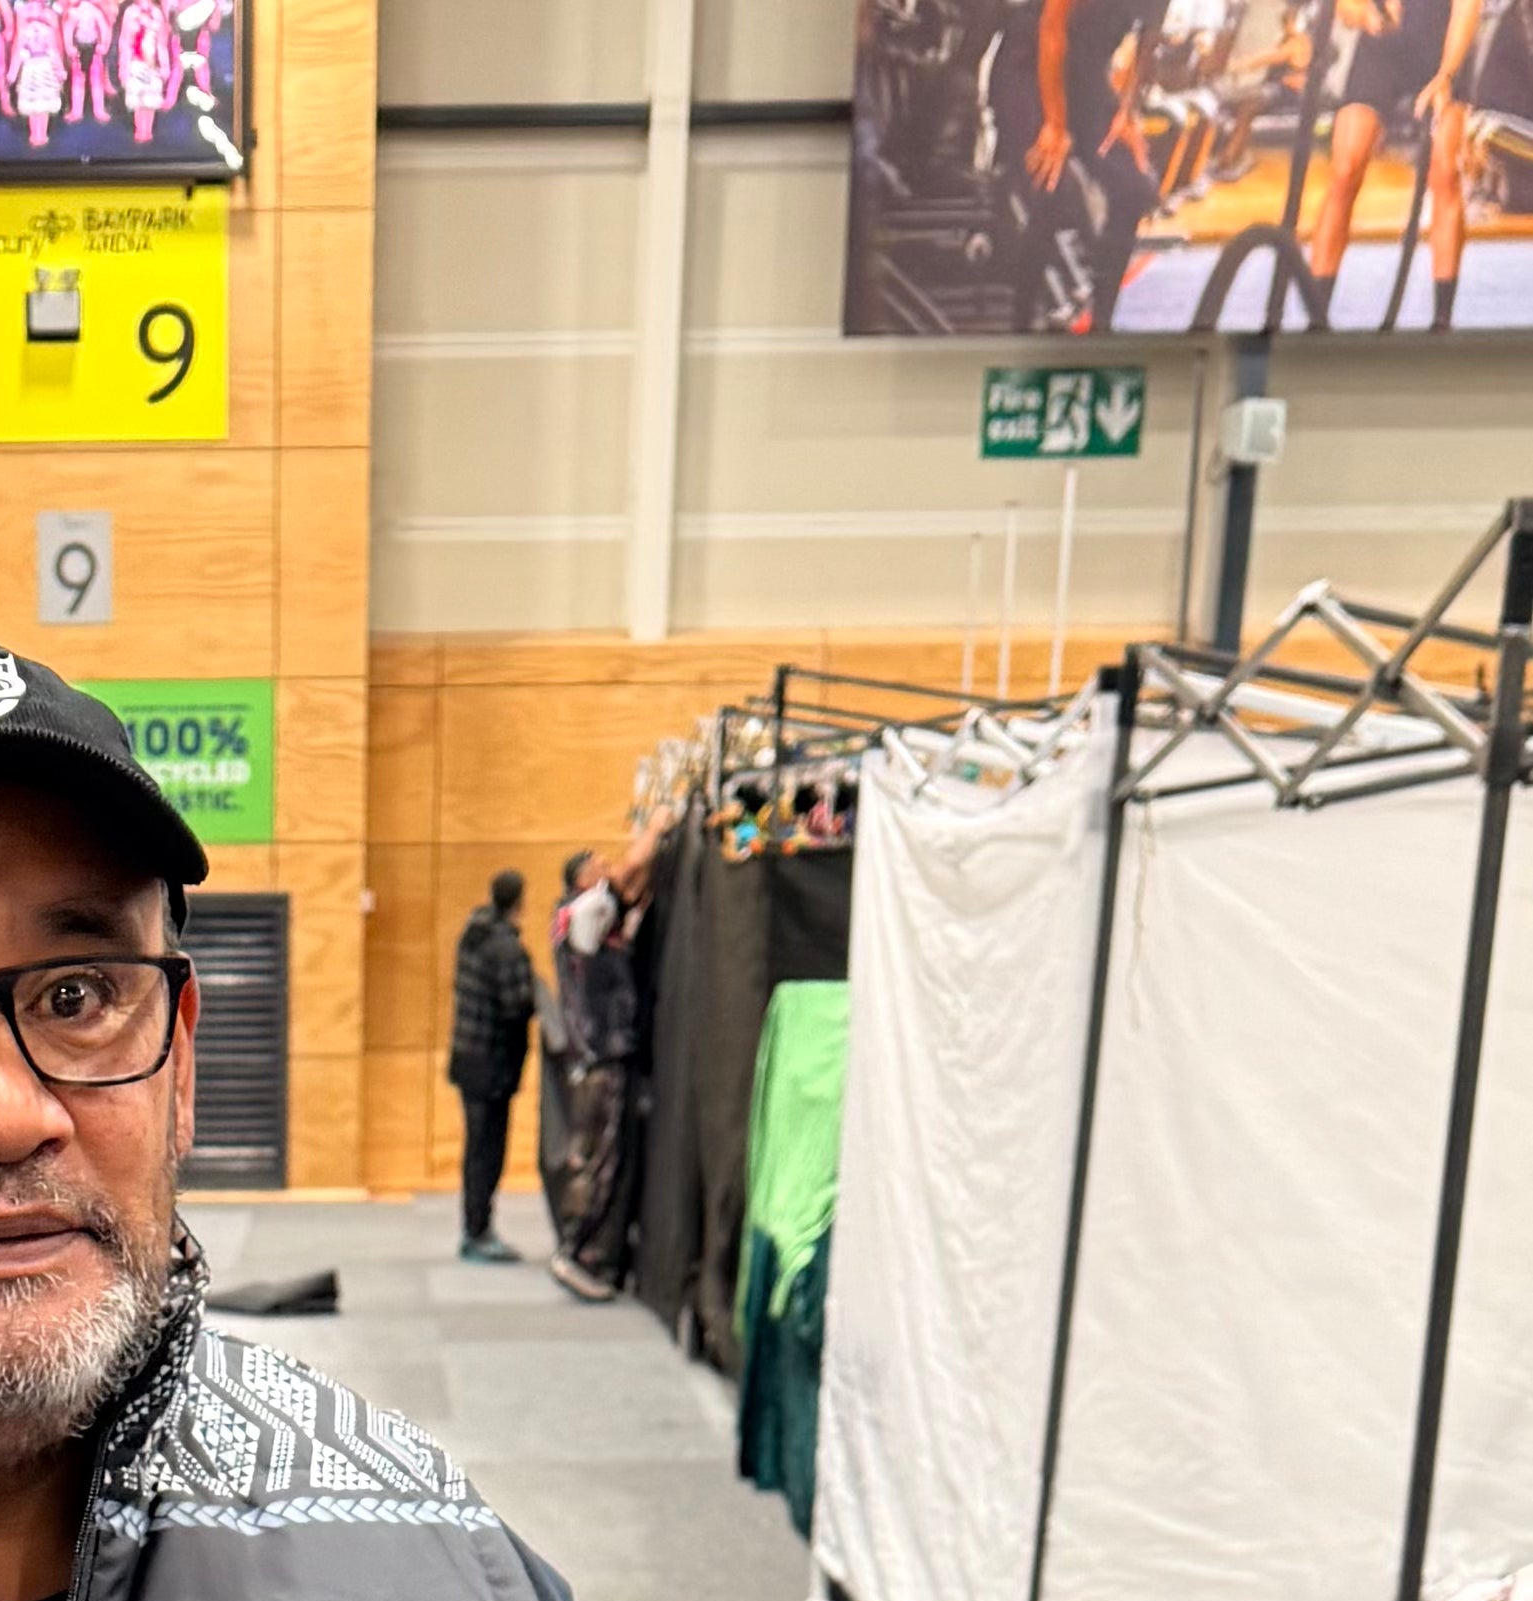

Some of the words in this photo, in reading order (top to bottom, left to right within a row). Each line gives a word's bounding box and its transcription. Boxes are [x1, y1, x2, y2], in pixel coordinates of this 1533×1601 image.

[138, 302, 196, 404] 9
[988, 383, 1043, 412] Fire
[987, 414, 1038, 442] exit
[55, 541, 98, 616] 9
[126, 718, 248, 756] 100%
